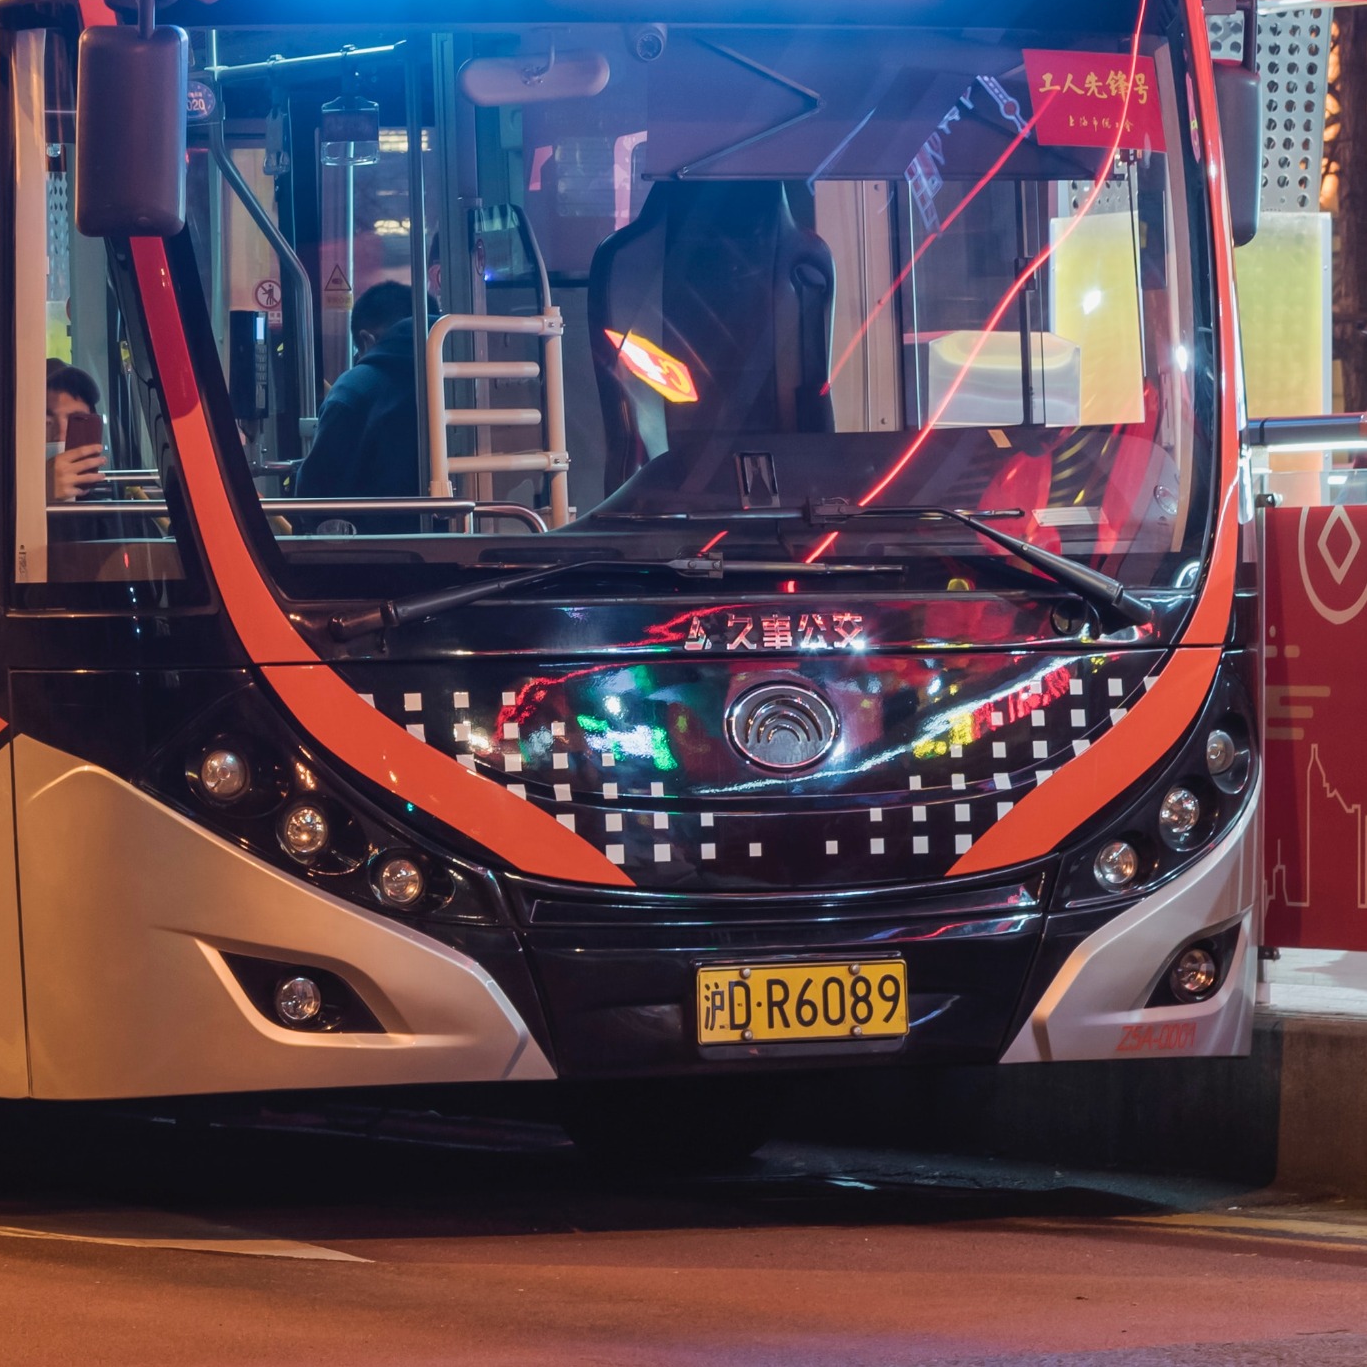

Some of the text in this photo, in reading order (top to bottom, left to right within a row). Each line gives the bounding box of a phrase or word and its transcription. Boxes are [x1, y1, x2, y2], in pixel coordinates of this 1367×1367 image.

[1039, 70, 1148, 105] 工人先锋号
[727, 612, 864, 651] 久事公交
